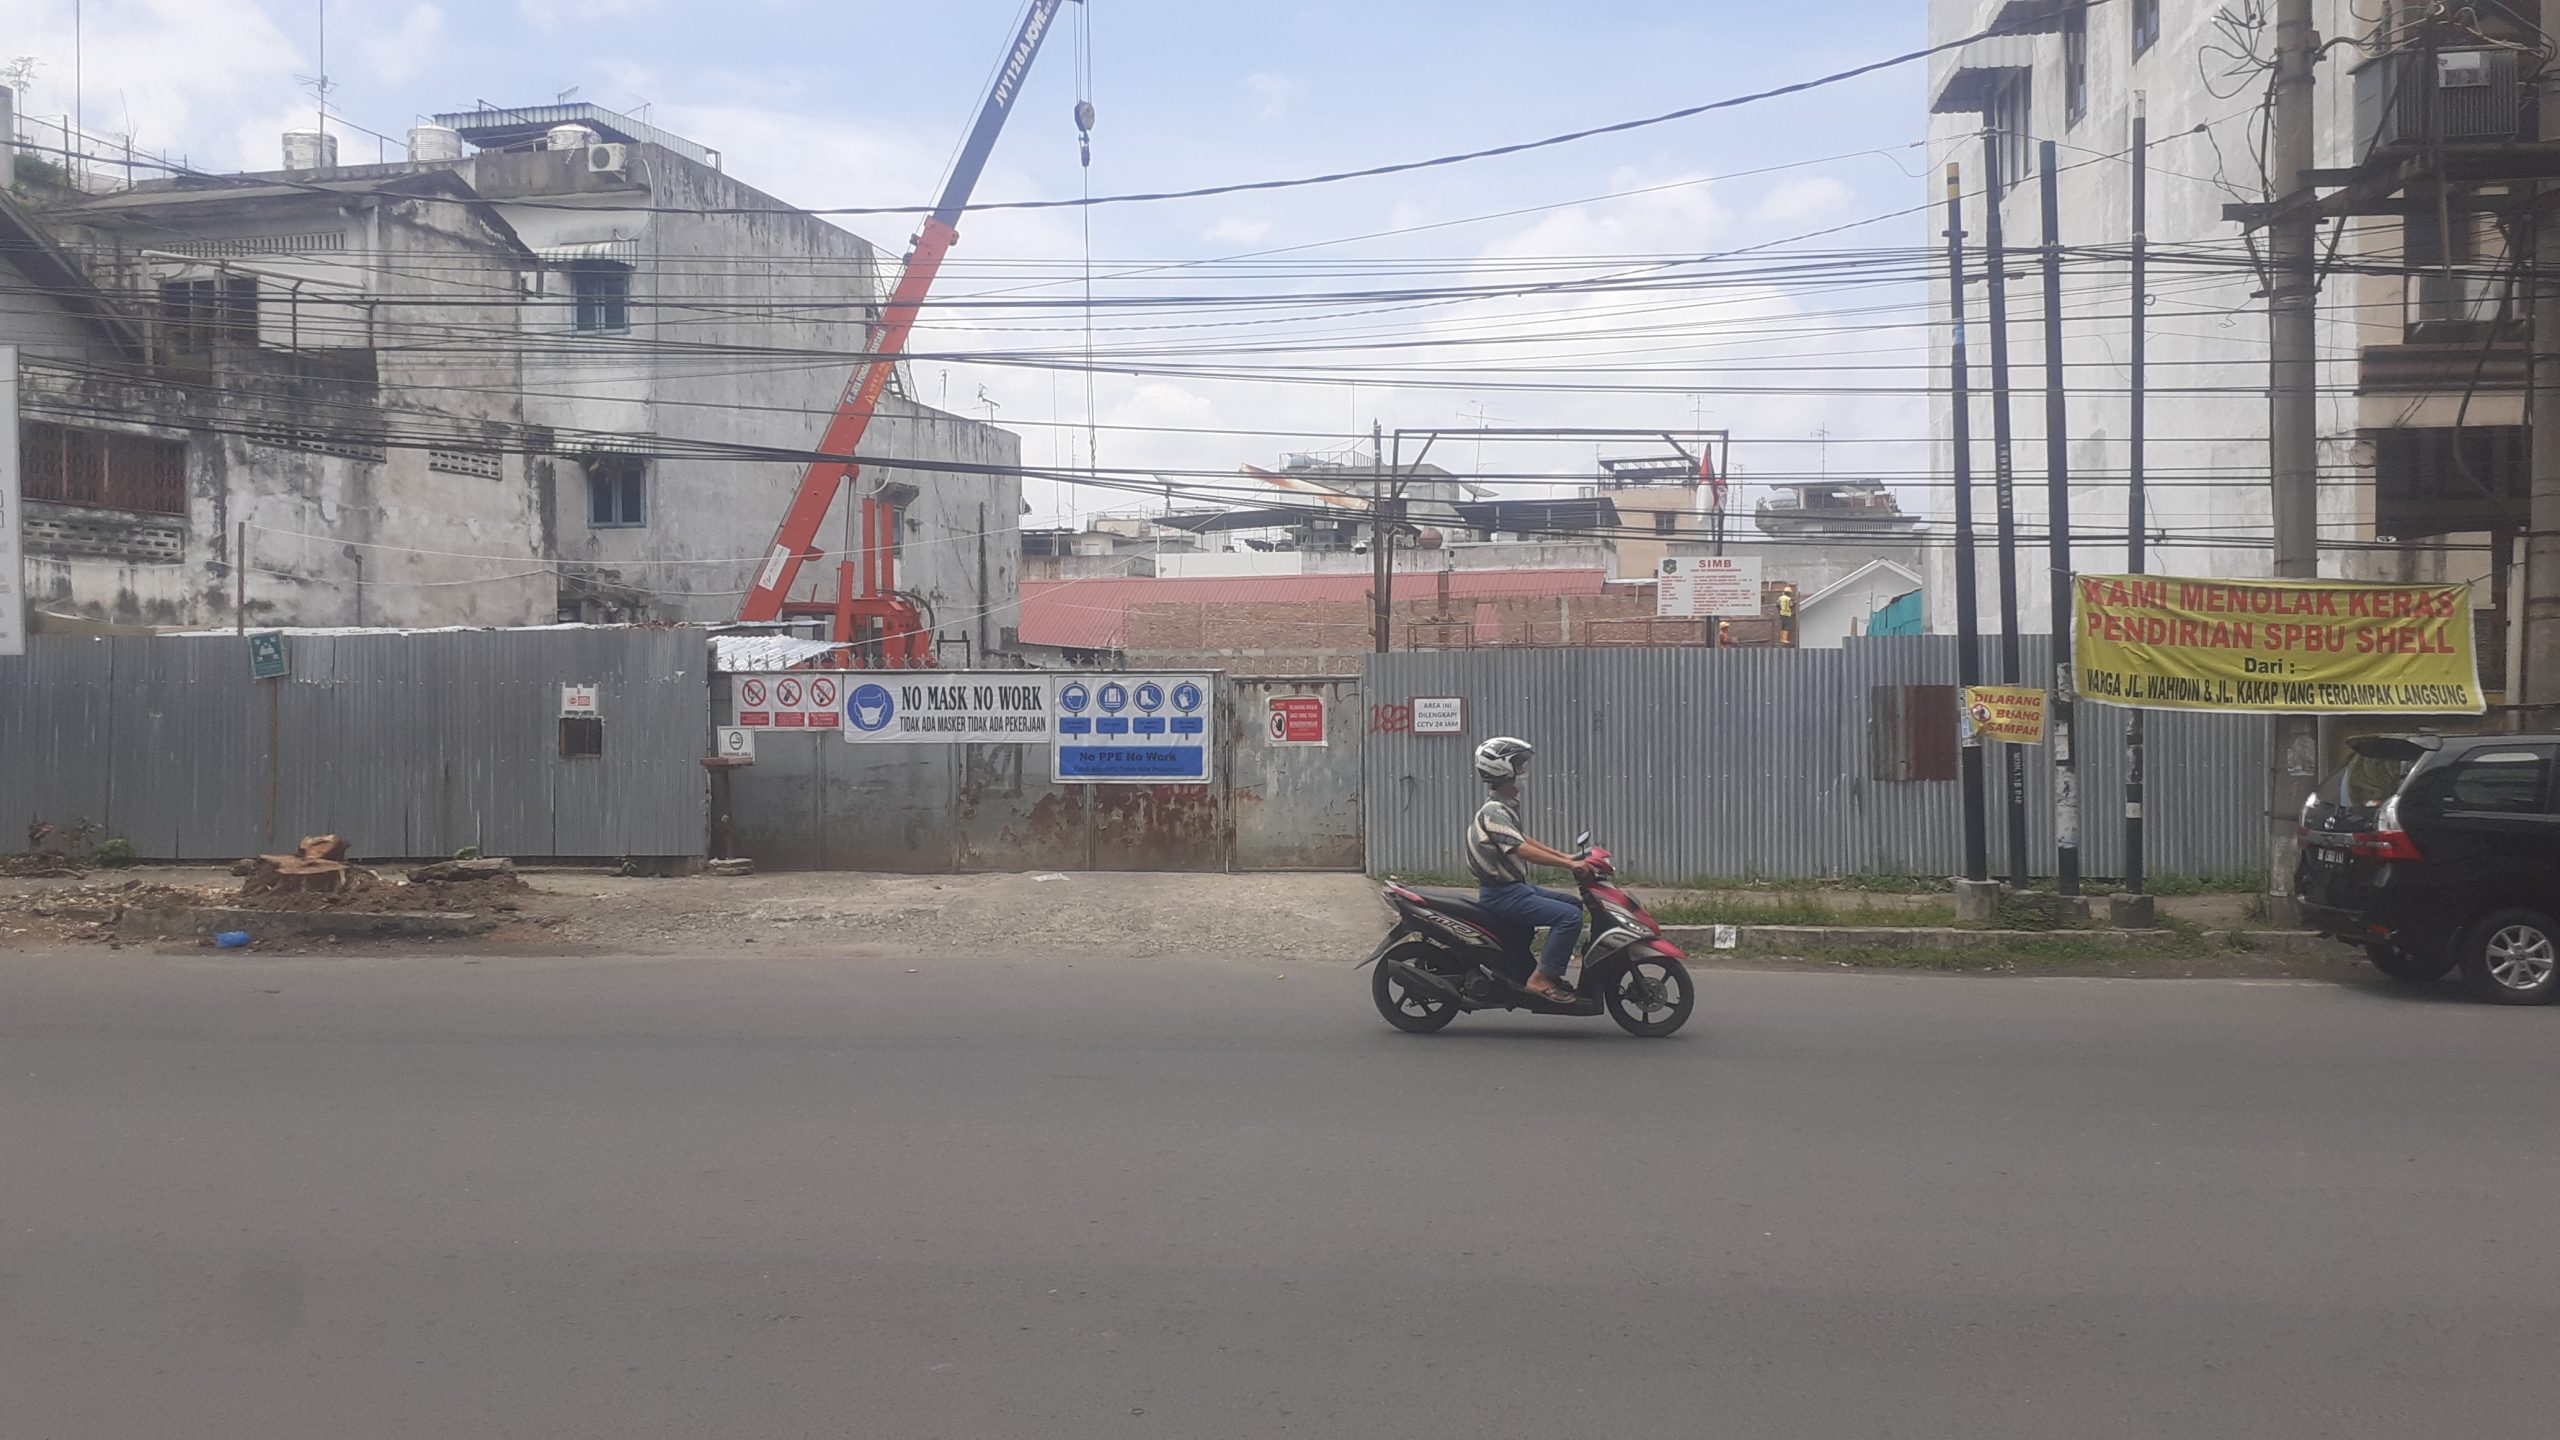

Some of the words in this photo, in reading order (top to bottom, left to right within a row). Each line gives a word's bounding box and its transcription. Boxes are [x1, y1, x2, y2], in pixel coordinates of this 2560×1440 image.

[1698, 559, 1732, 568] SIMB
[2084, 578, 2168, 611] KAMI
[2179, 583, 2338, 617] MENOLAK
[2349, 589, 2455, 619] KERAS
[2086, 611, 2255, 650] PENDIRIAN
[2263, 624, 2346, 653] SPBU
[2355, 626, 2455, 654] SHELL
[2244, 656, 2284, 675] Dari
[2087, 668, 2122, 698] WARGA
[2124, 673, 2144, 699] JL.
[2147, 676, 2201, 701] WAHIDIN
[2203, 681, 2213, 703] &
[2215, 682, 2233, 704] JL.
[2236, 682, 2280, 705] KAKAP
[2283, 683, 2317, 706] YANG
[2318, 684, 2394, 706] TERDAMPAK
[2394, 684, 2469, 706] LANGSUNG
[901, 686, 922, 711] NO
[927, 685, 968, 711] MASK
[973, 686, 994, 711] NO
[998, 685, 1043, 711] WORK
[1974, 693, 2041, 707] DILARANG
[1418, 711, 1458, 719] DILENGKAPI
[1995, 709, 2040, 721] BUANG
[900, 715, 920, 732] TIDAK
[921, 716, 936, 732] ADA
[937, 716, 966, 732] MASKER
[967, 716, 988, 732] TIDAK
[989, 716, 1003, 732] ADA
[1004, 716, 1047, 732] PEKERJAAN
[1986, 722, 2040, 736] SAMPAH
[1079, 752, 1096, 762] No
[1099, 752, 1123, 762] PPE
[1126, 752, 1143, 762] No
[1146, 752, 1177, 762] Work
